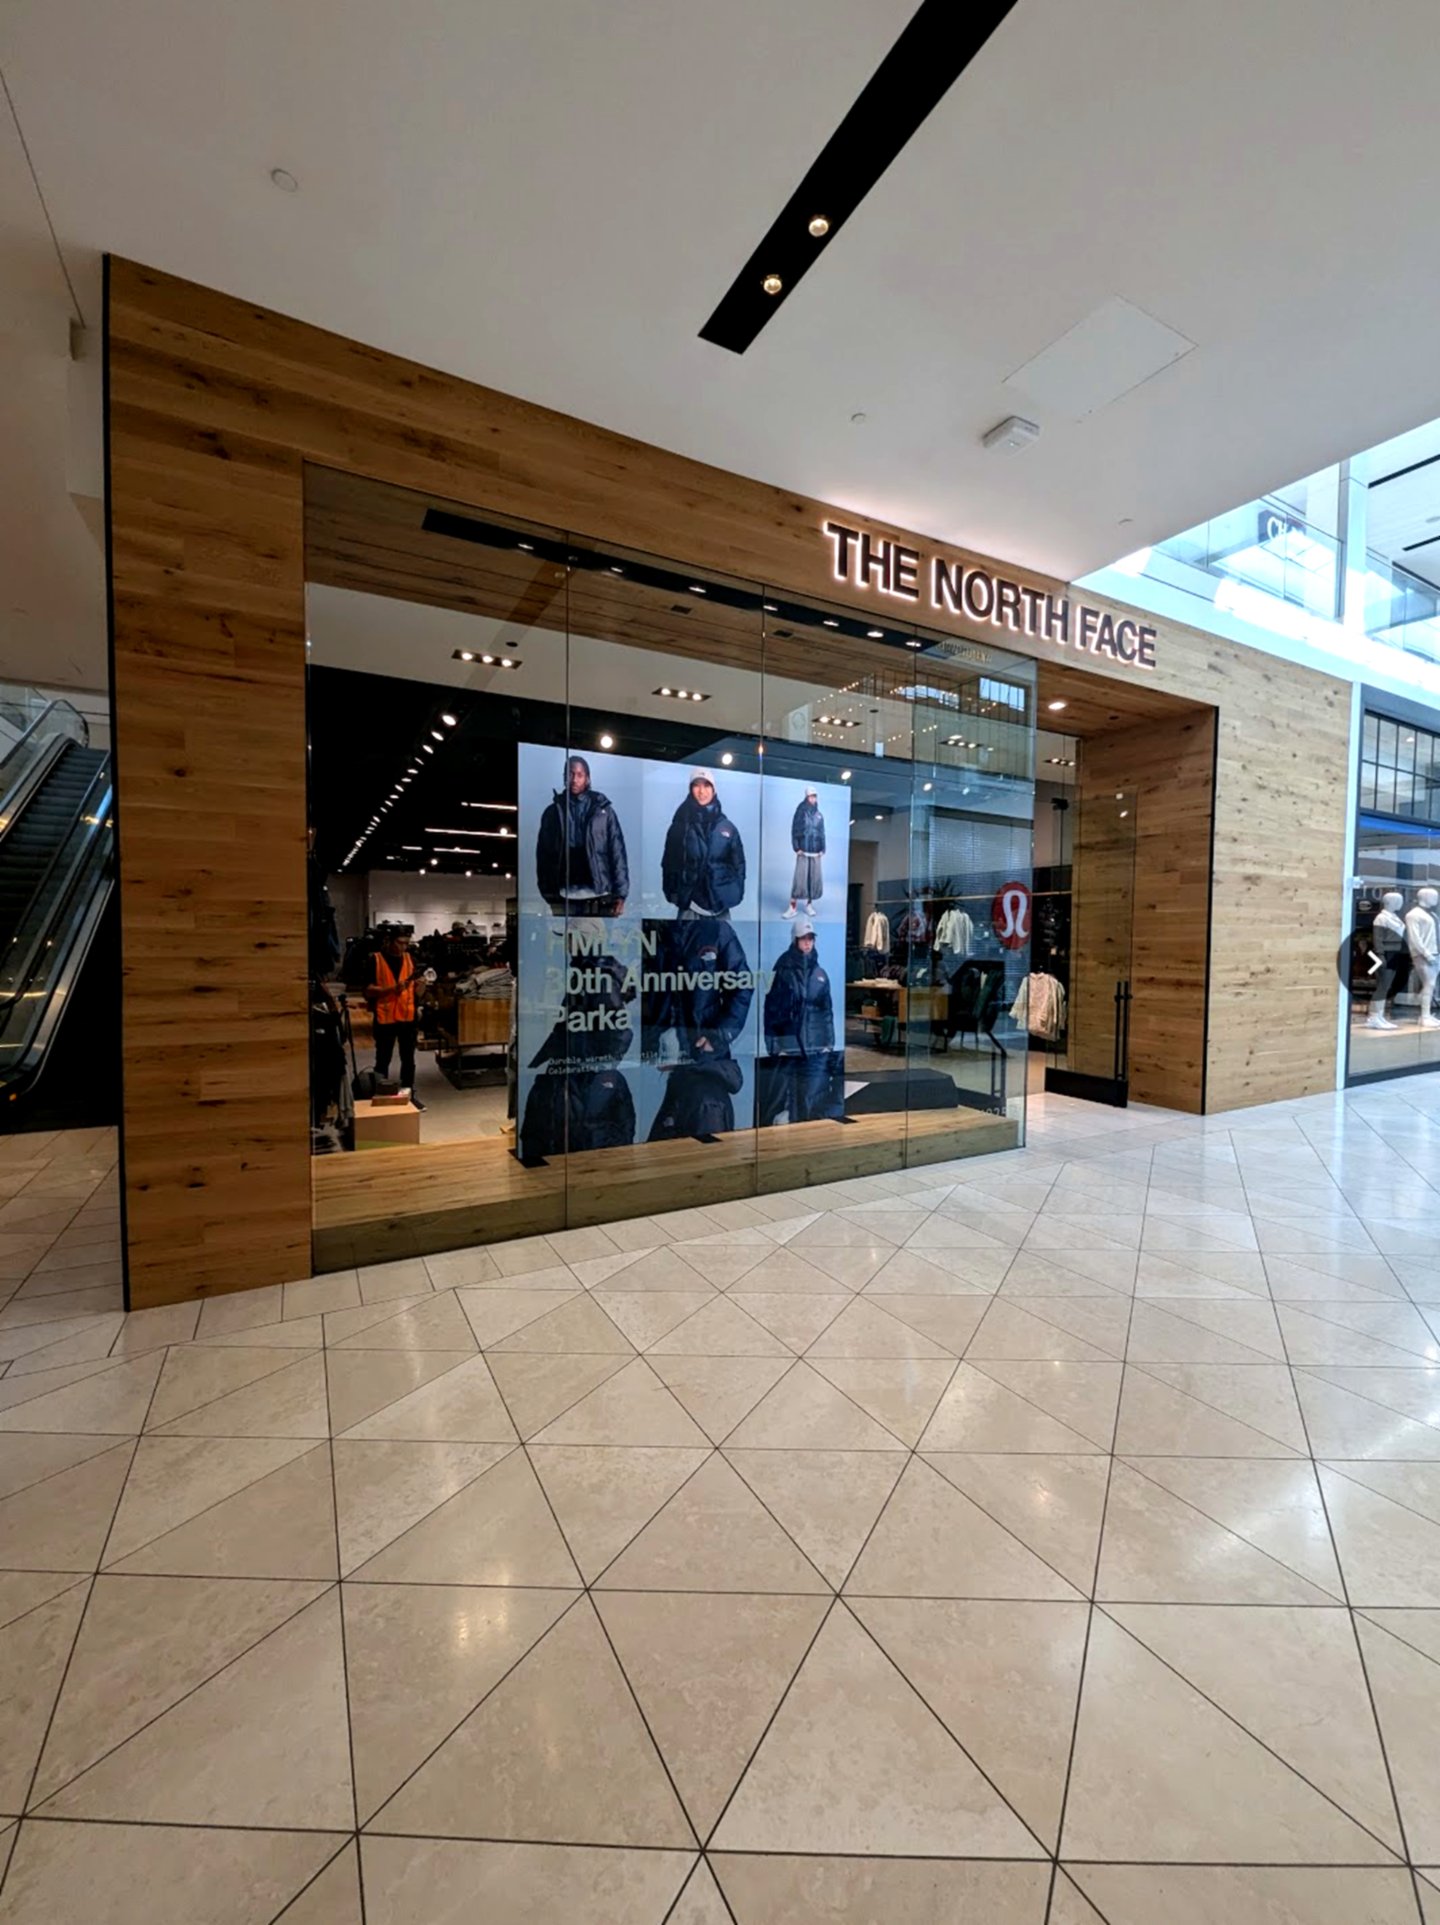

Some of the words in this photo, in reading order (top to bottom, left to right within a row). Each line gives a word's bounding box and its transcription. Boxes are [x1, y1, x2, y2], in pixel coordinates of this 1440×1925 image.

[825, 521, 920, 599] THE
[932, 557, 1070, 644] NORTH
[1077, 604, 1157, 669] FACE
[620, 965, 777, 995] Anniversary
[551, 1003, 633, 1033] Parka
